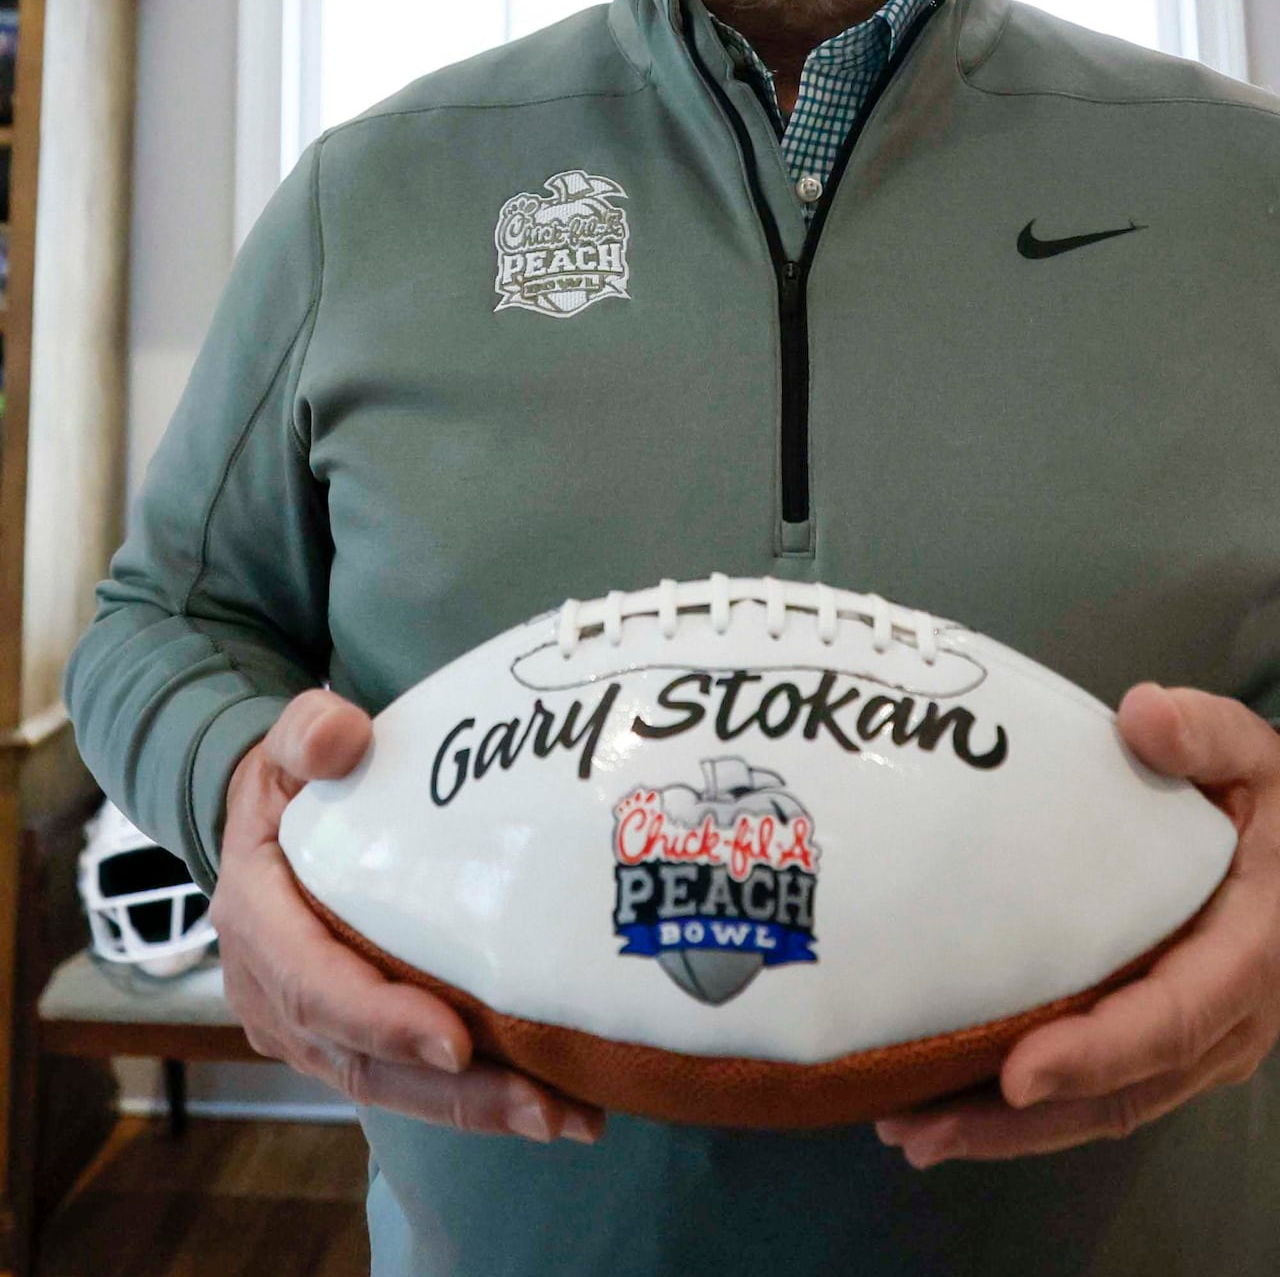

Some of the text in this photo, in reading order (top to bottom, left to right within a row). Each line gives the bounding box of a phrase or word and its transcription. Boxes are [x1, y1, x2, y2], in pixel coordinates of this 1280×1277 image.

[502, 243, 624, 285] PEACH
[430, 669, 1009, 806] Gary Stokan
[617, 802, 813, 879] Chick-fil-A
[617, 866, 815, 933] PEACH
[658, 921, 777, 949] BOWL
